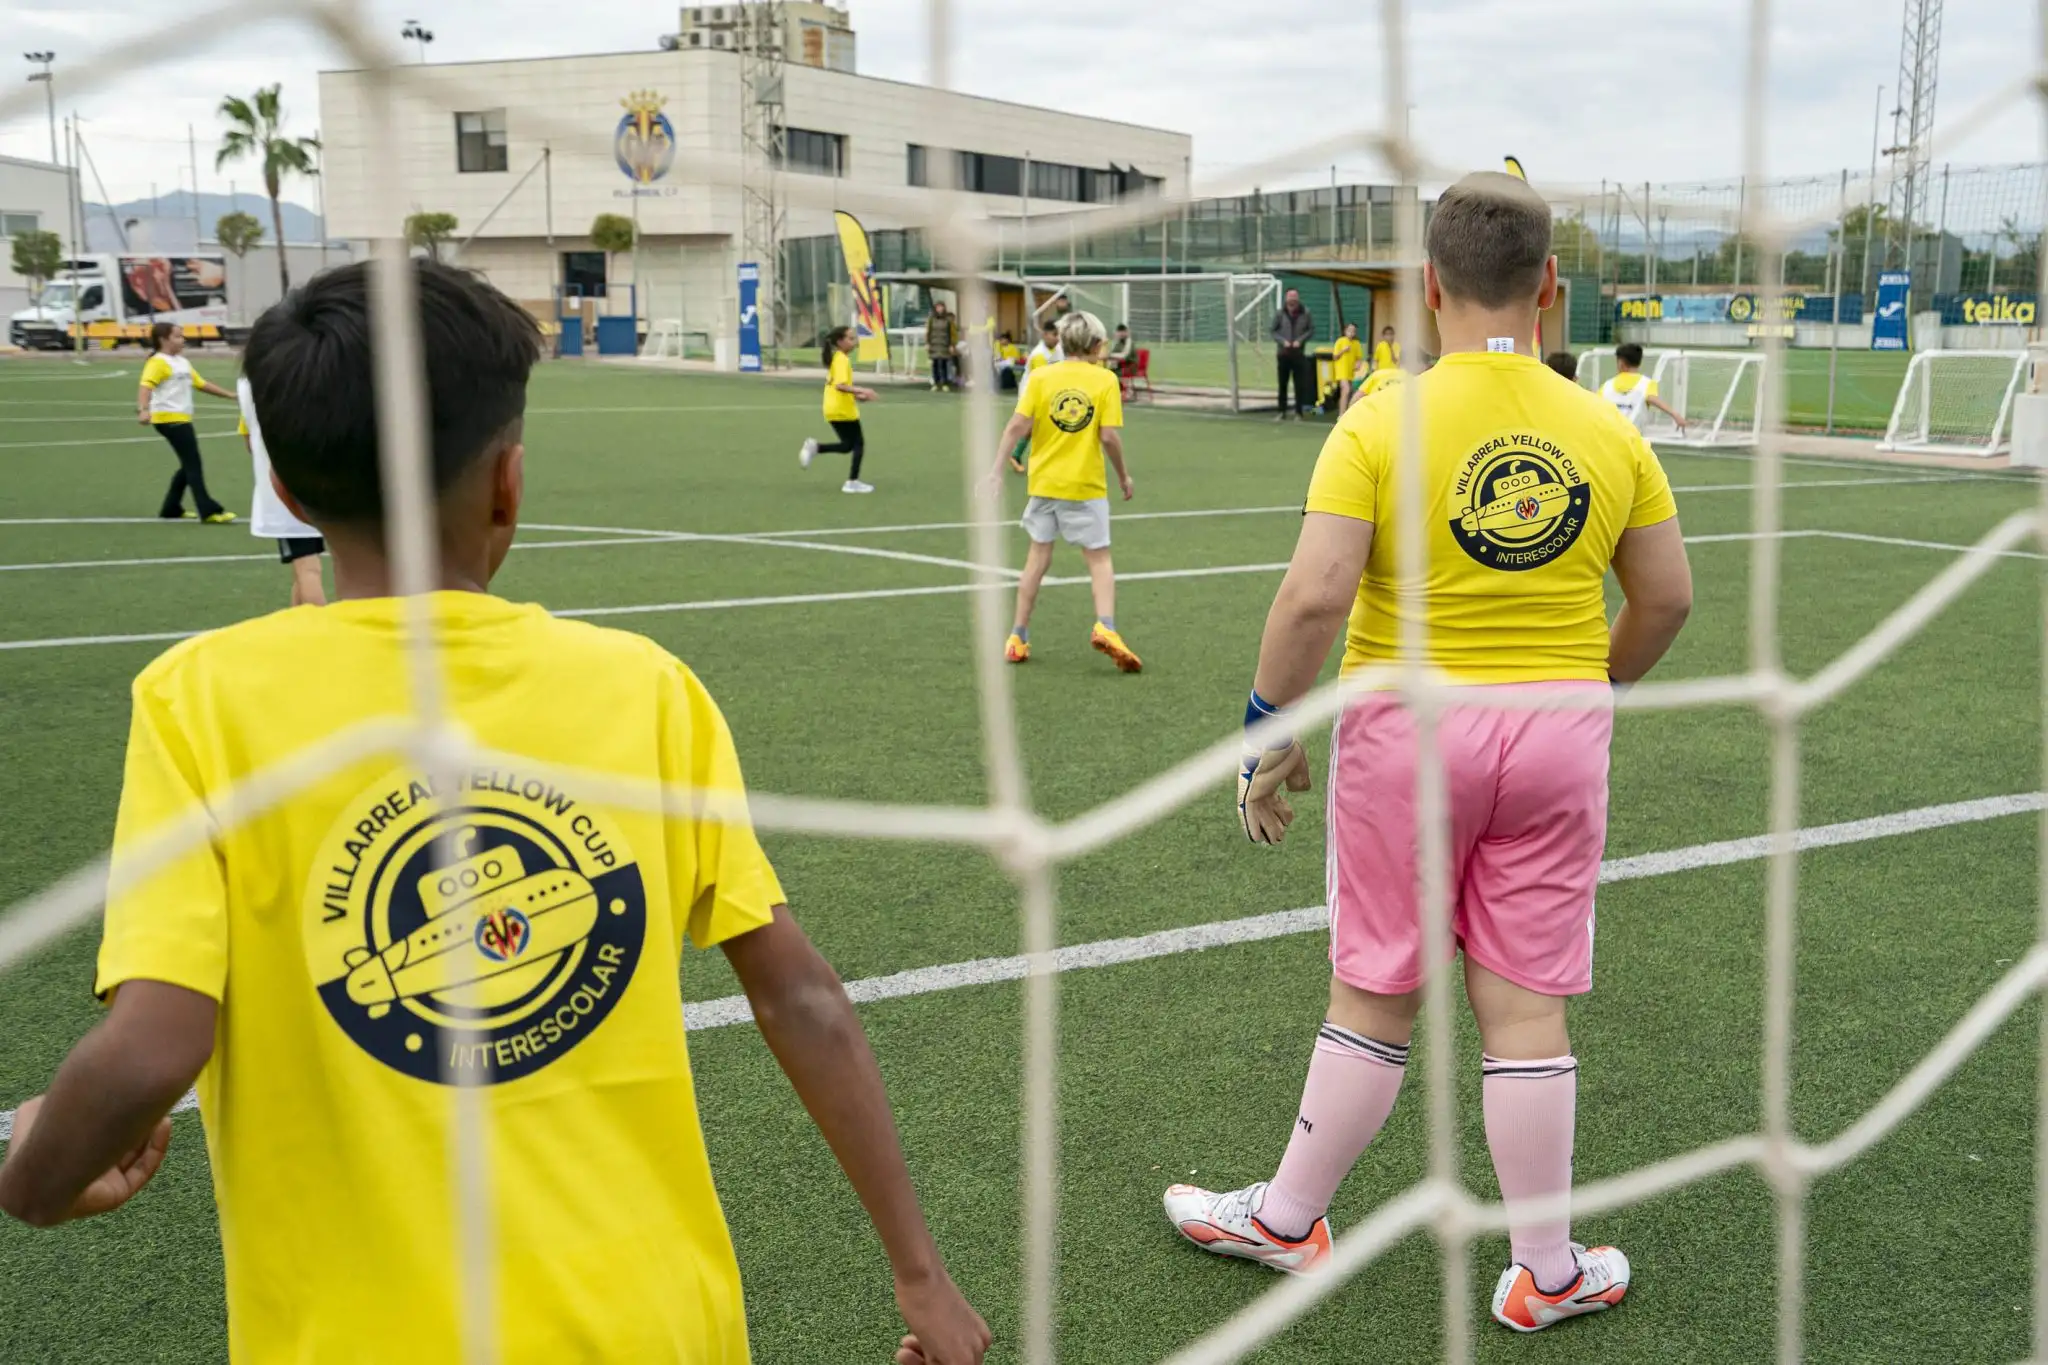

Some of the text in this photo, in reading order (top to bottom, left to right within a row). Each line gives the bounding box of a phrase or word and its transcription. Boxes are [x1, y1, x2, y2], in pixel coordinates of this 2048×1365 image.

[1963, 295, 2035, 324] teika
[1456, 434, 1580, 496] VILLARREAL YELLOW CUP
[1496, 517, 1580, 564] INTERESCOLAR
[571, 814, 617, 868] CUP
[450, 942, 626, 1071] INTERESCOLAR
